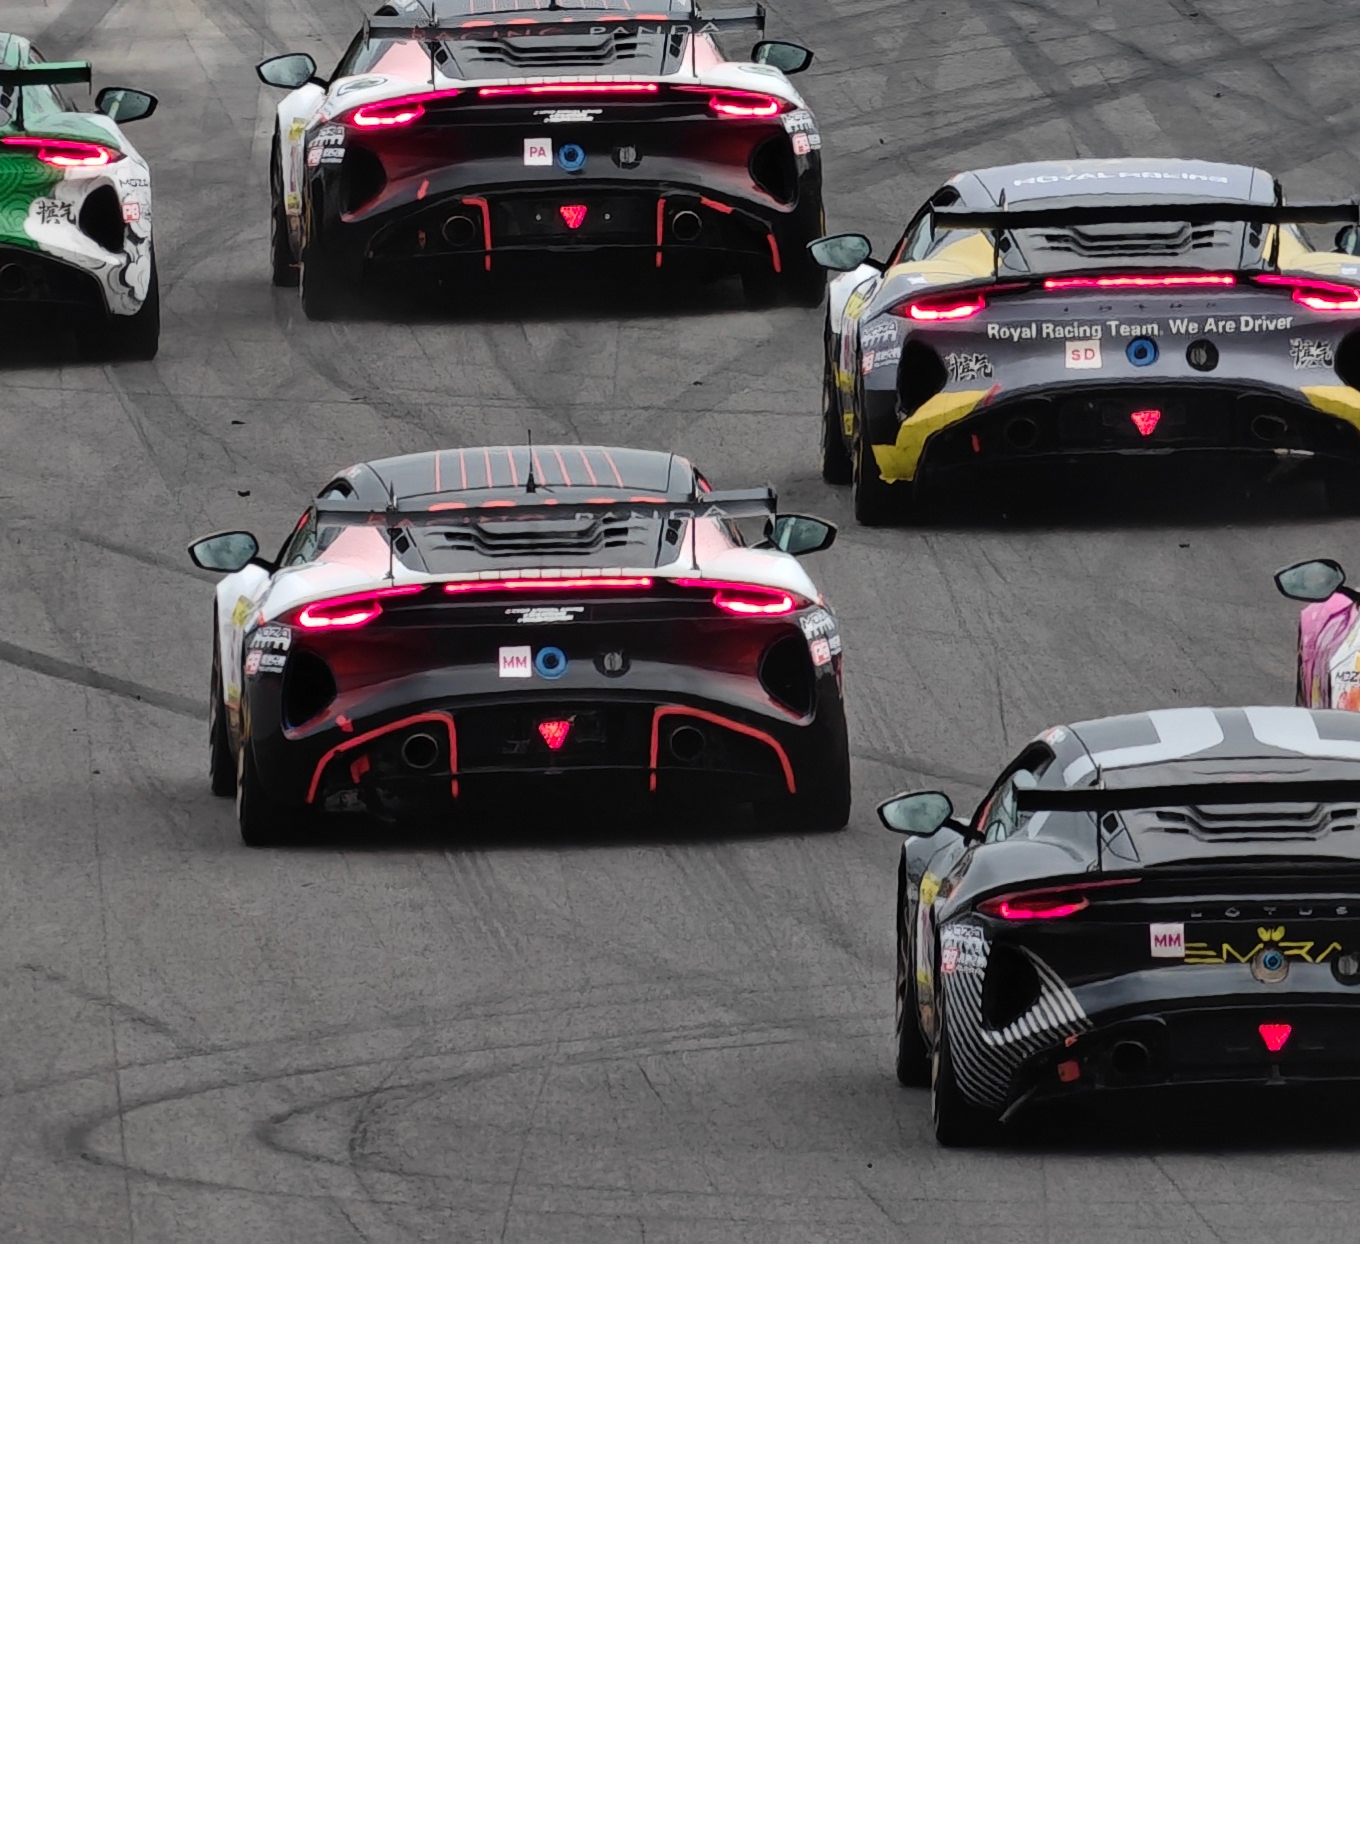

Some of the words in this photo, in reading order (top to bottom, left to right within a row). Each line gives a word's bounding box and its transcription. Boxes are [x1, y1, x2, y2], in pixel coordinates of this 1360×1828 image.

[589, 22, 720, 35] PANDA
[529, 146, 547, 158] PA
[987, 322, 1037, 342] Royal
[1042, 322, 1103, 340] Racing
[1168, 318, 1199, 334] We
[1204, 317, 1236, 333] Are
[1240, 315, 1294, 333] Driver
[1071, 347, 1095, 361] SD
[256, 627, 290, 640] OZA
[503, 656, 528, 669] MM
[1191, 906, 1348, 918] LOTUS
[1154, 933, 1182, 948] MM
